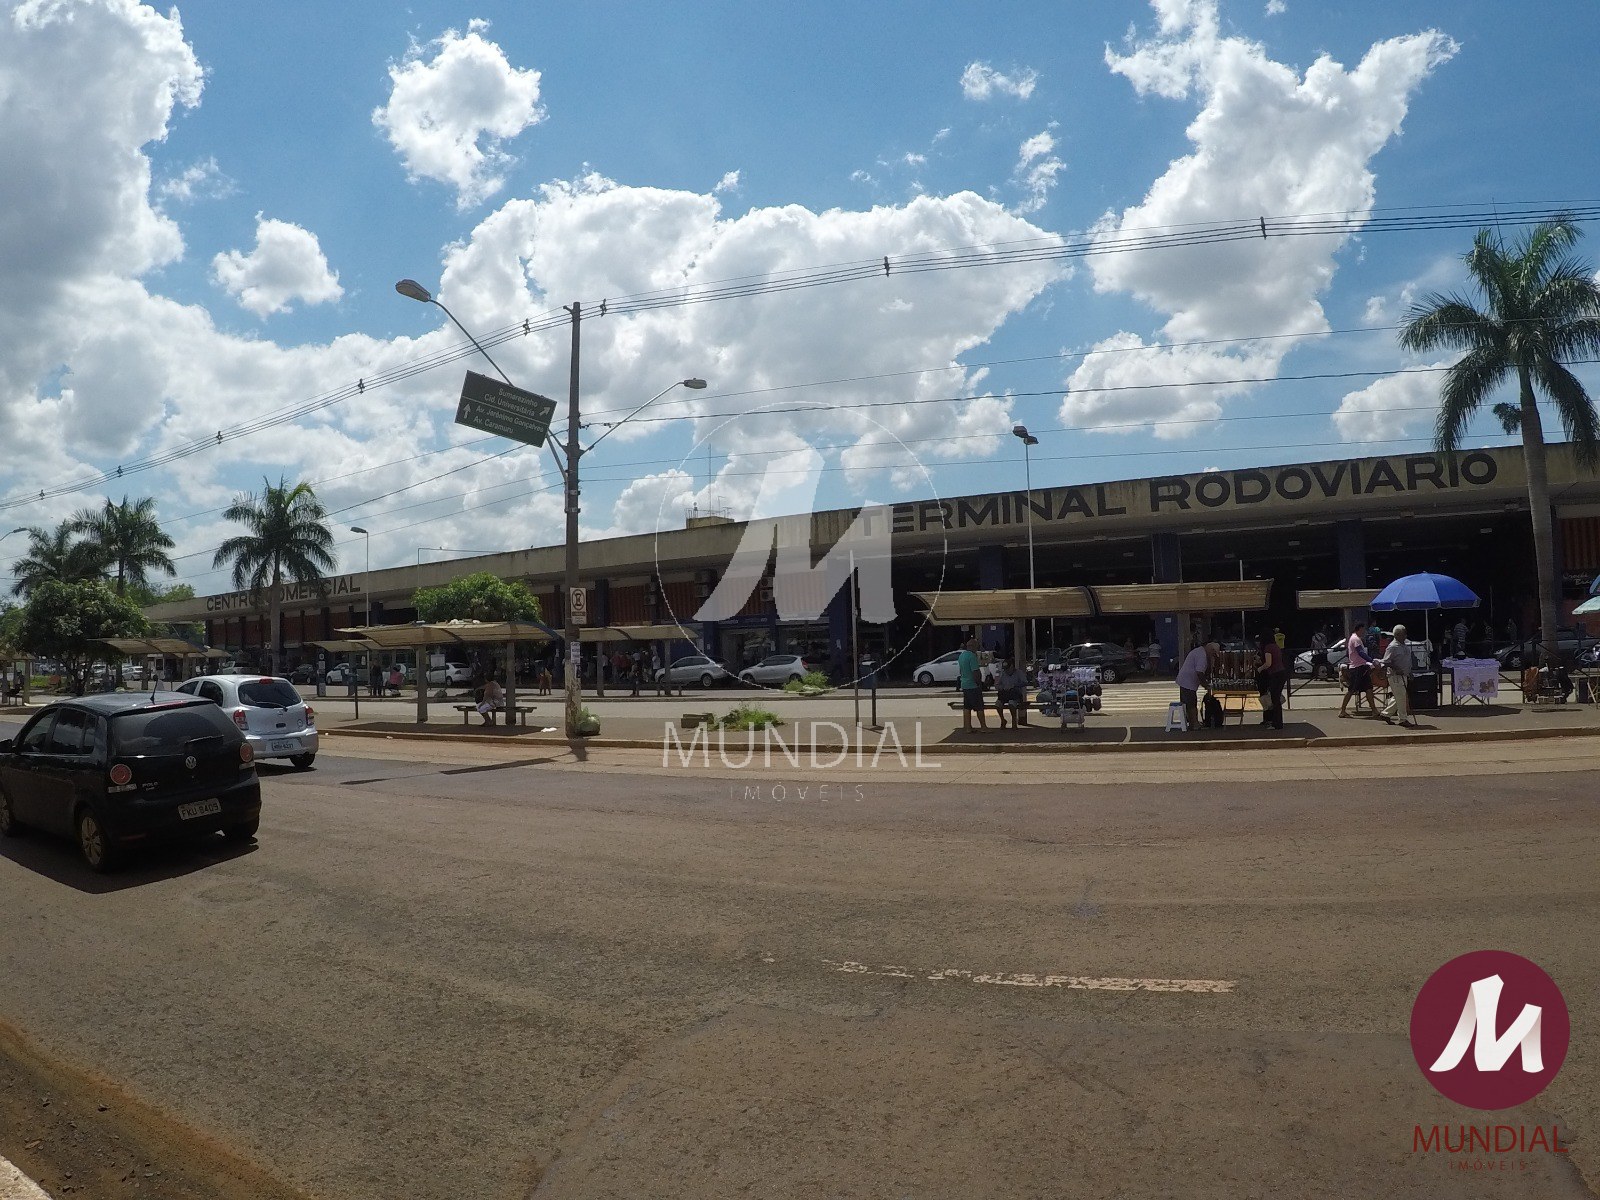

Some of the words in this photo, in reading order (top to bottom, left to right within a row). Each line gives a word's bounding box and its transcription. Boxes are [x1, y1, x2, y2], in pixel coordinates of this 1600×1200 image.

[498, 388, 538, 407] Sumarezinho
[484, 419, 514, 434] Caramuru
[514, 417, 544, 433] Gonçalves
[851, 485, 1127, 537] TERMINAL
[1150, 452, 1498, 512] RODOVIARIO
[266, 575, 360, 606] OMERCIAL
